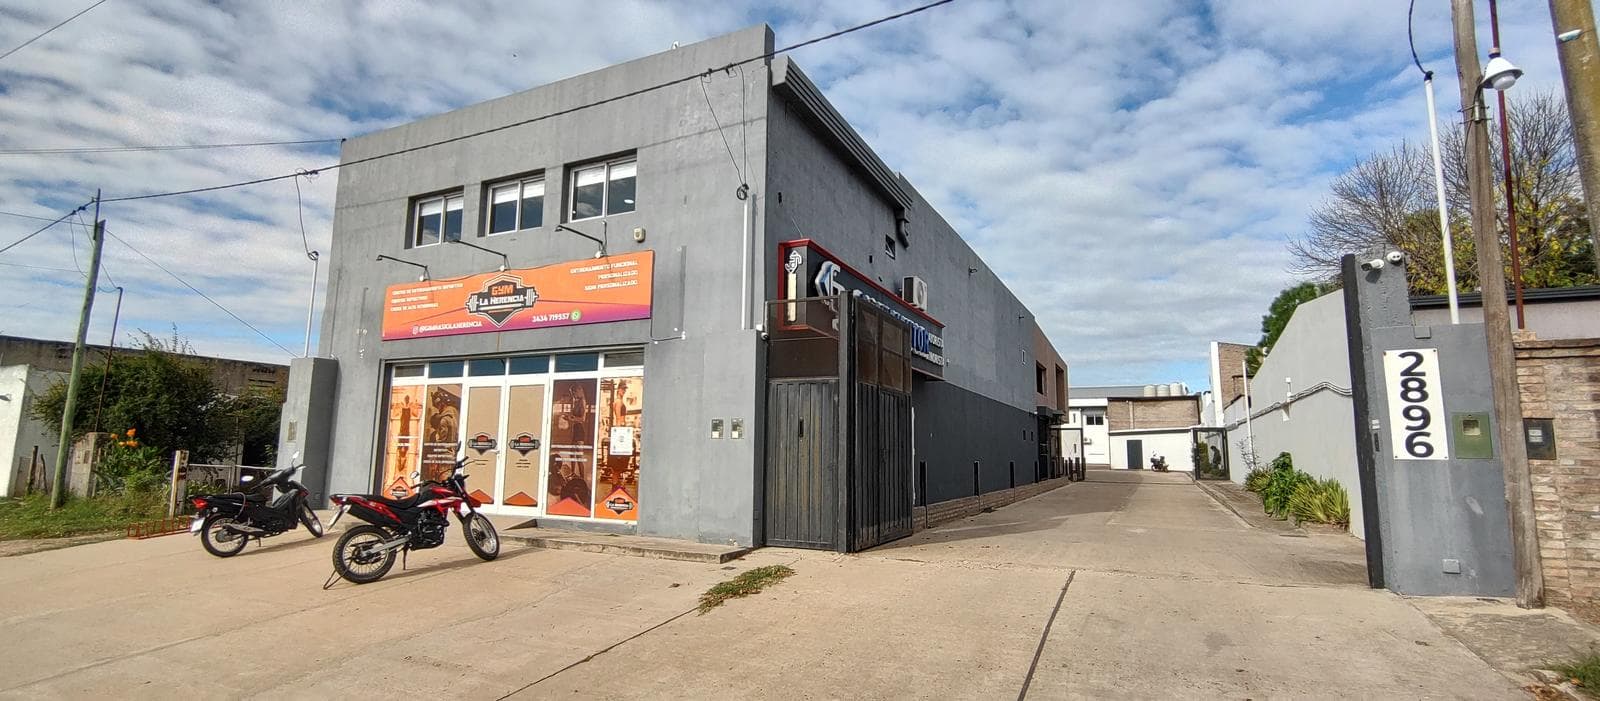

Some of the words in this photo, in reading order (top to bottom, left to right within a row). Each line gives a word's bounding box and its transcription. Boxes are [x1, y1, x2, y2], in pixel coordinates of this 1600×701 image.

[491, 284, 514, 296] GYM
[480, 298, 489, 306] LA
[490, 295, 525, 305] HERENCIA
[1397, 351, 1435, 459] 2896
